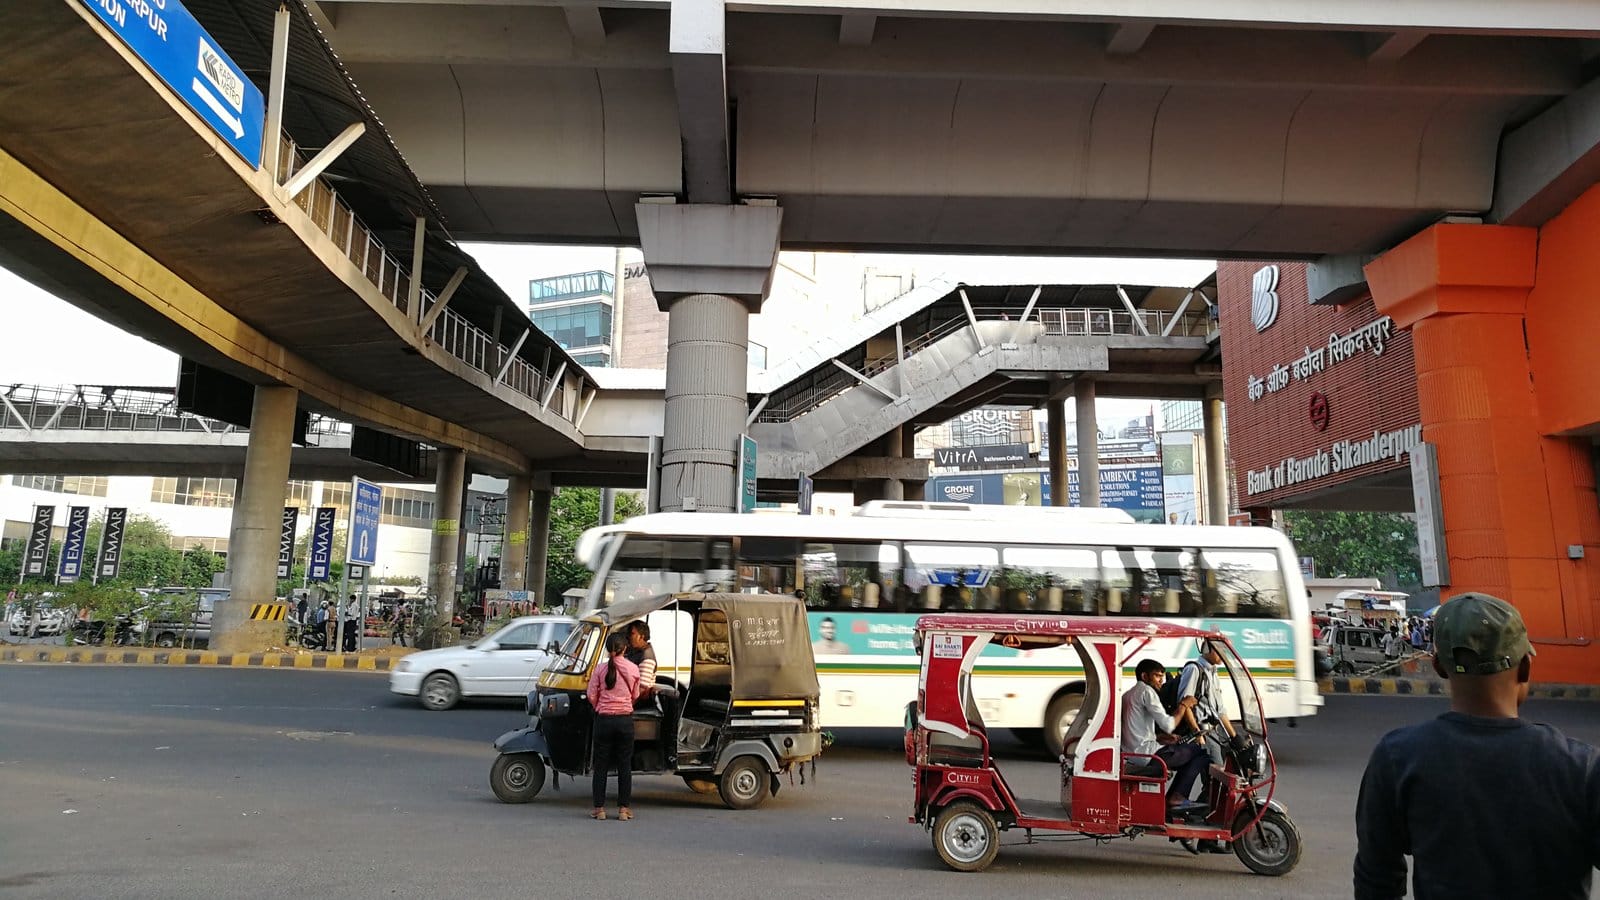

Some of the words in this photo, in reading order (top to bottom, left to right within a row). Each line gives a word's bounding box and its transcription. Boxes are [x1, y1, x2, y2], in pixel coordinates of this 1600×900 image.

[95, 0, 126, 28] ION
[219, 63, 236, 89] RAPID
[220, 79, 241, 105] METRO
[1248, 375, 1264, 402] बैंक
[1247, 465, 1273, 496] Bank
[1274, 459, 1285, 489] of
[1287, 448, 1329, 485] Baroda
[1332, 424, 1421, 472] Sikanderpur
[944, 485, 975, 493] GROHE
[32, 508, 52, 559] EMAAR
[67, 508, 86, 560] EMAAR
[105, 510, 123, 562] EMAAR
[278, 510, 295, 563] EMAAR
[314, 510, 332, 563] EMAAR
